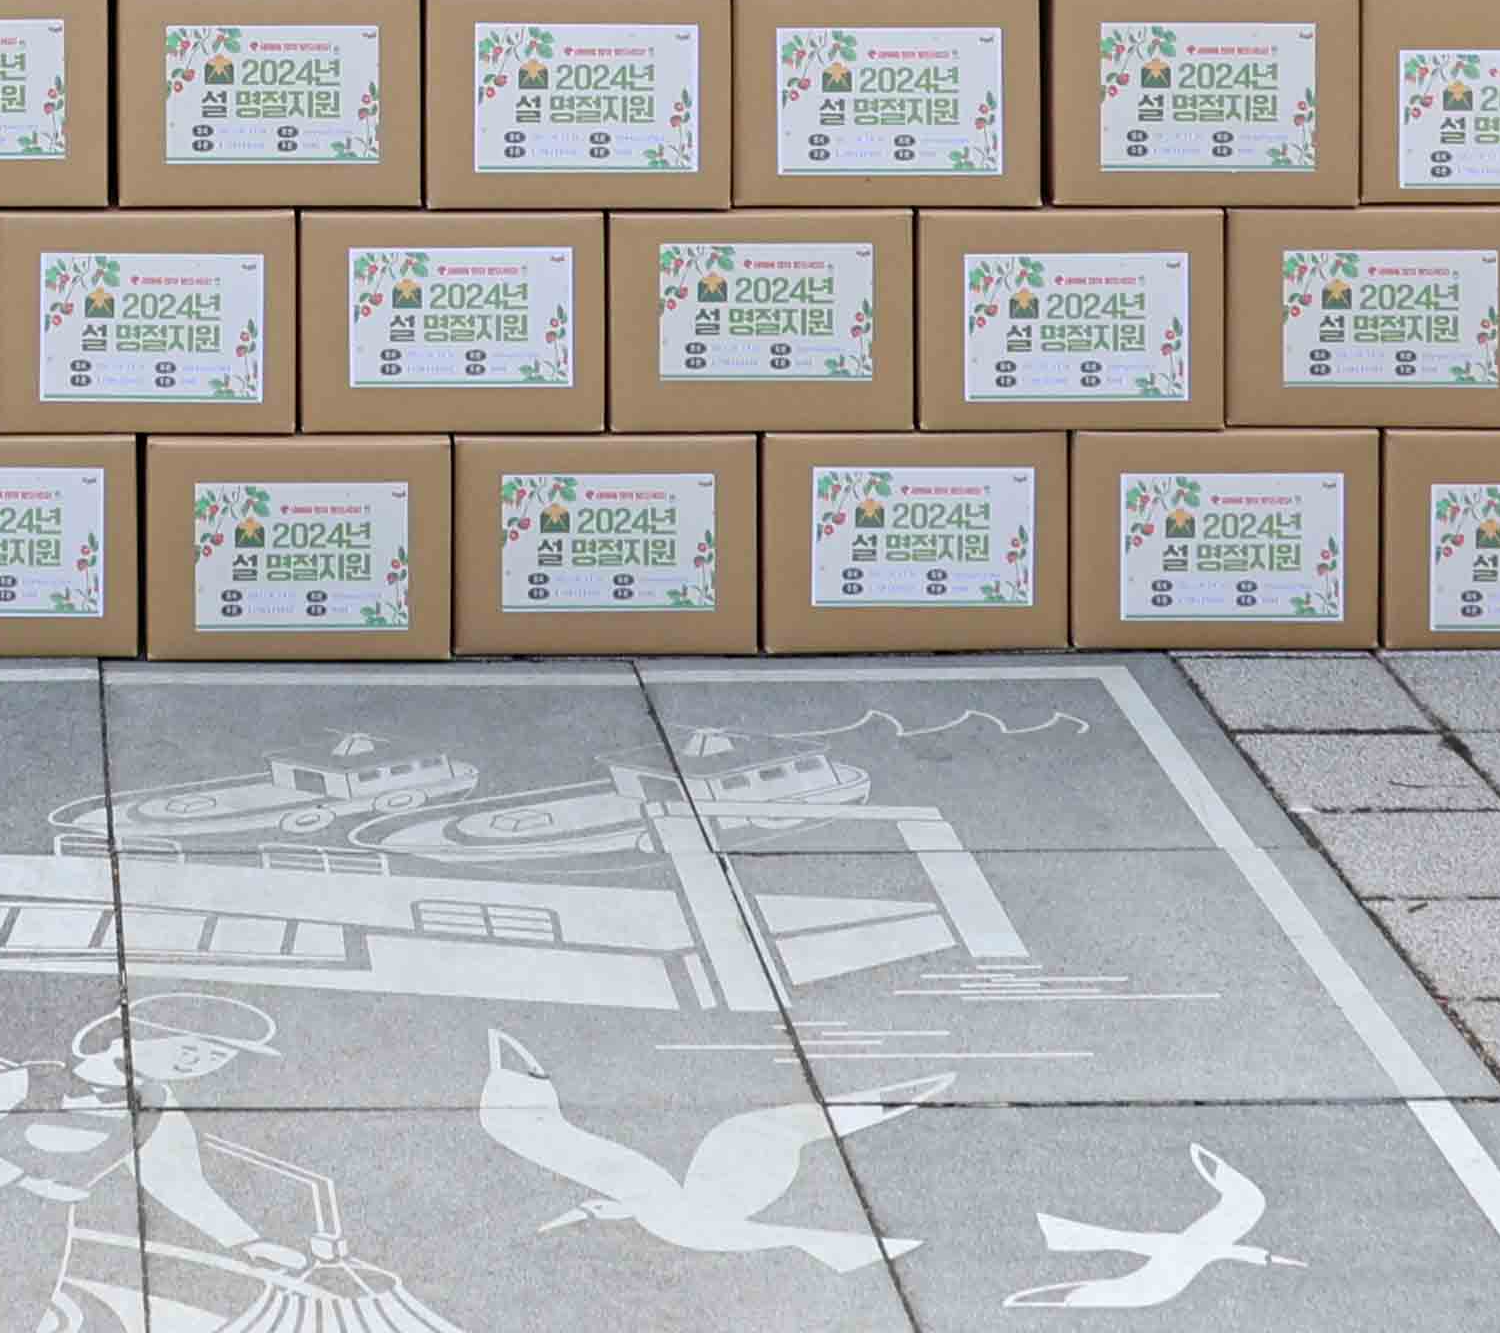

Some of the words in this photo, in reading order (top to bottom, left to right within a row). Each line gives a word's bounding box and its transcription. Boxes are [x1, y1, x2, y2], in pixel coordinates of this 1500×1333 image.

[556, 63, 655, 92] 2024년
[1179, 62, 1278, 90] 2024년
[515, 96, 542, 124] 설
[549, 95, 655, 124] 명절지원
[1138, 95, 1164, 123] 설
[1172, 94, 1278, 123] 명절지원
[430, 282, 529, 310] 2024년
[1047, 291, 1146, 321] 2024년
[390, 315, 416, 342] 설
[424, 313, 530, 342] 명절지원
[1006, 325, 1032, 353] 설
[1040, 323, 1146, 353] 명절지원
[893, 502, 991, 530] 2024년
[273, 521, 371, 550] 2024년
[853, 534, 878, 561] 설
[886, 533, 991, 562] 명절지원
[232, 554, 258, 582] 설
[266, 553, 372, 583] 명절지원
[1472, 555, 1498, 583] 설
